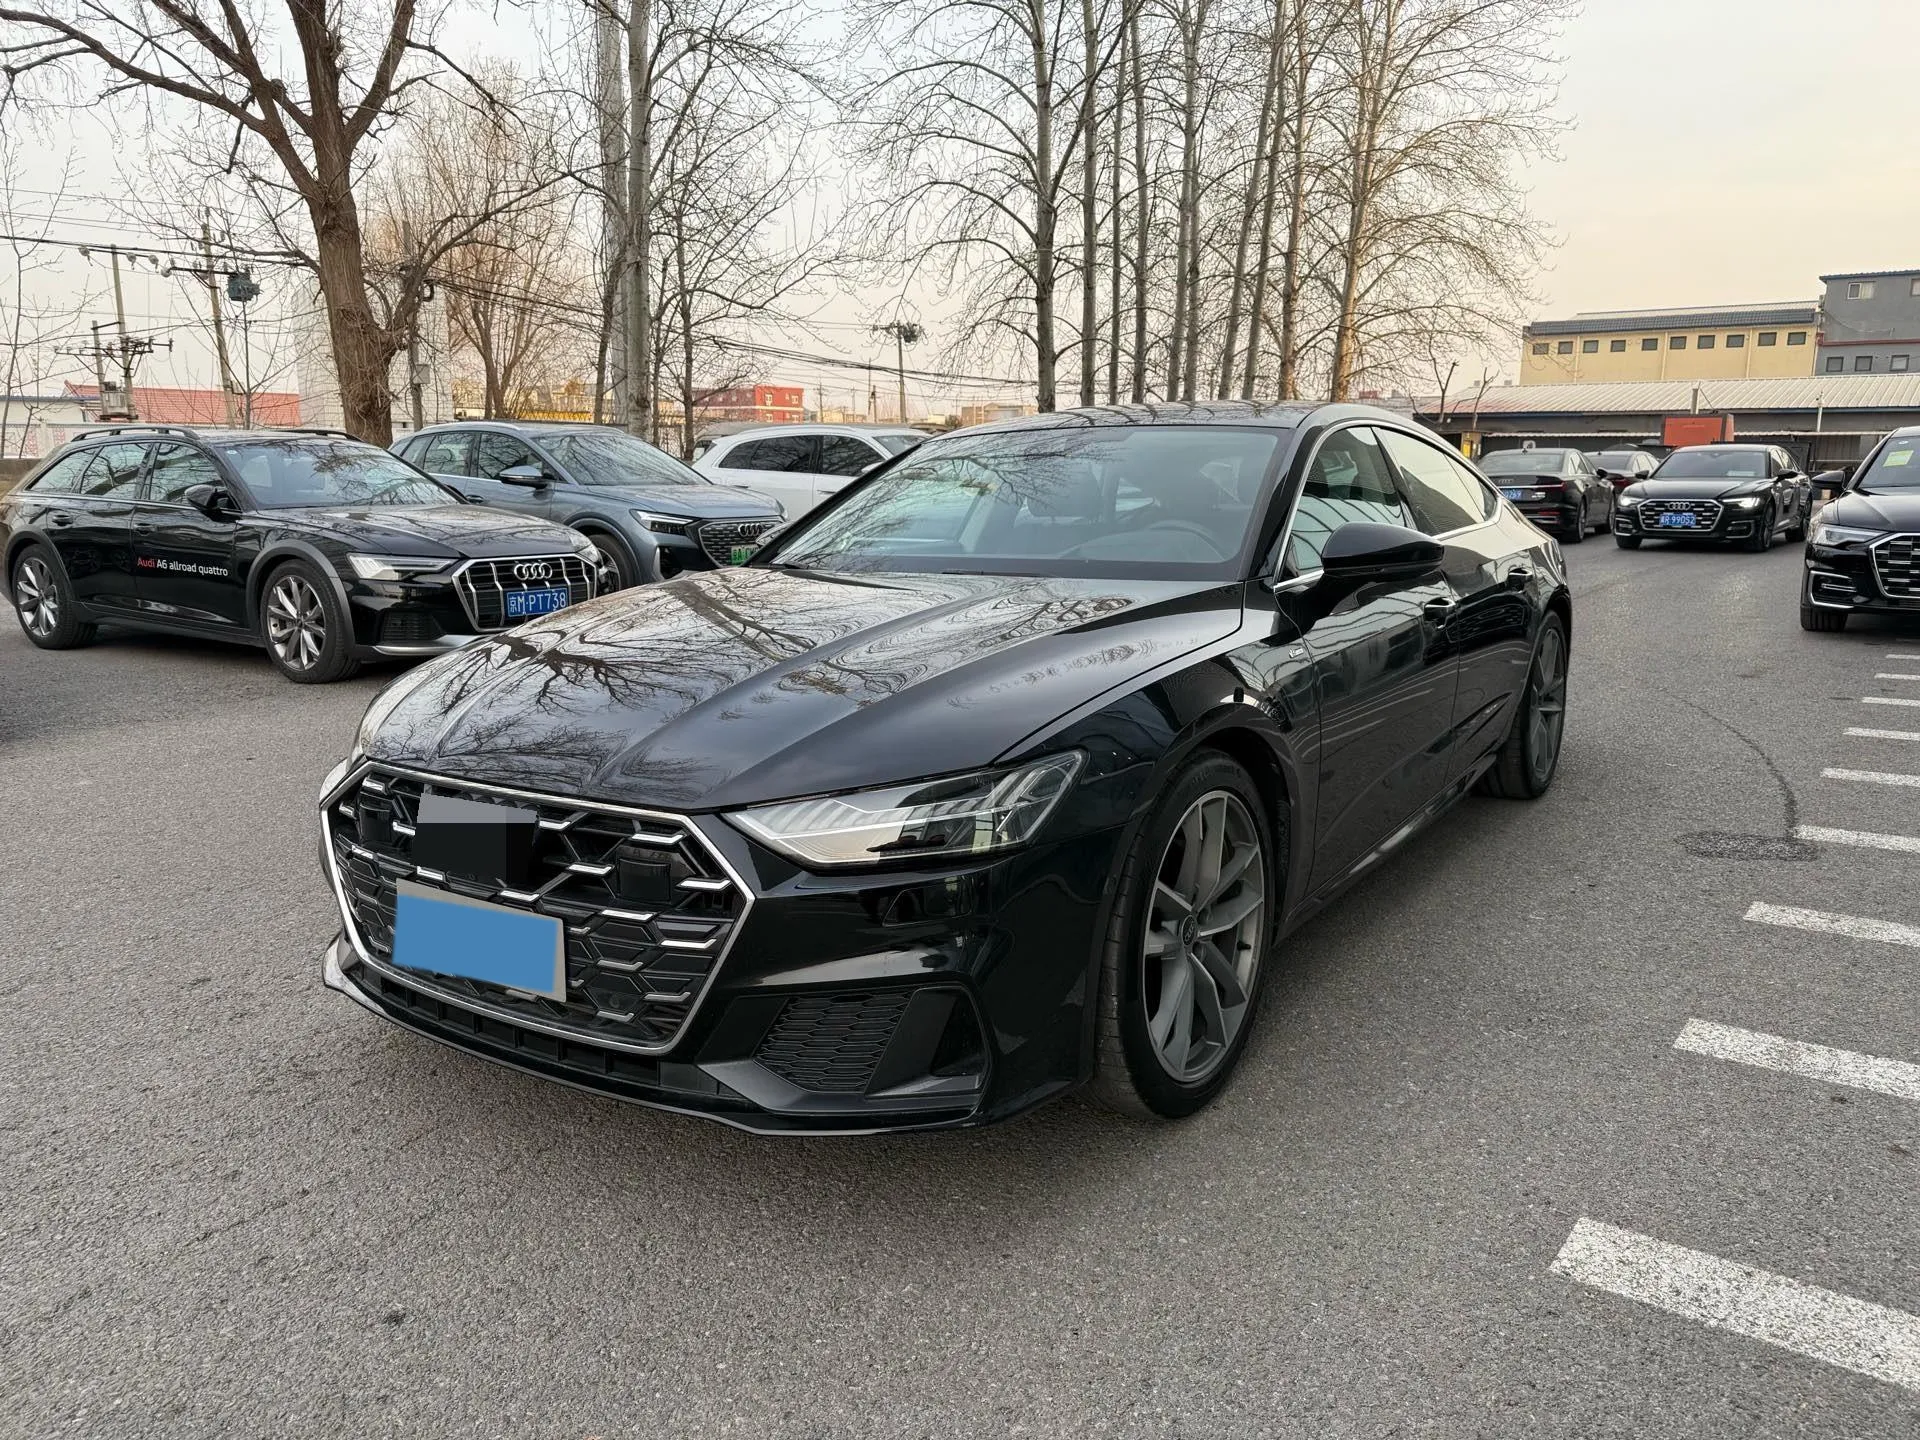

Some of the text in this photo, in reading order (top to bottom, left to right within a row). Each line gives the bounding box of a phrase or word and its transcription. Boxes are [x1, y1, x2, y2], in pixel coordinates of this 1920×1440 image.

[137, 557, 228, 576] Audi A6 allroad quattro
